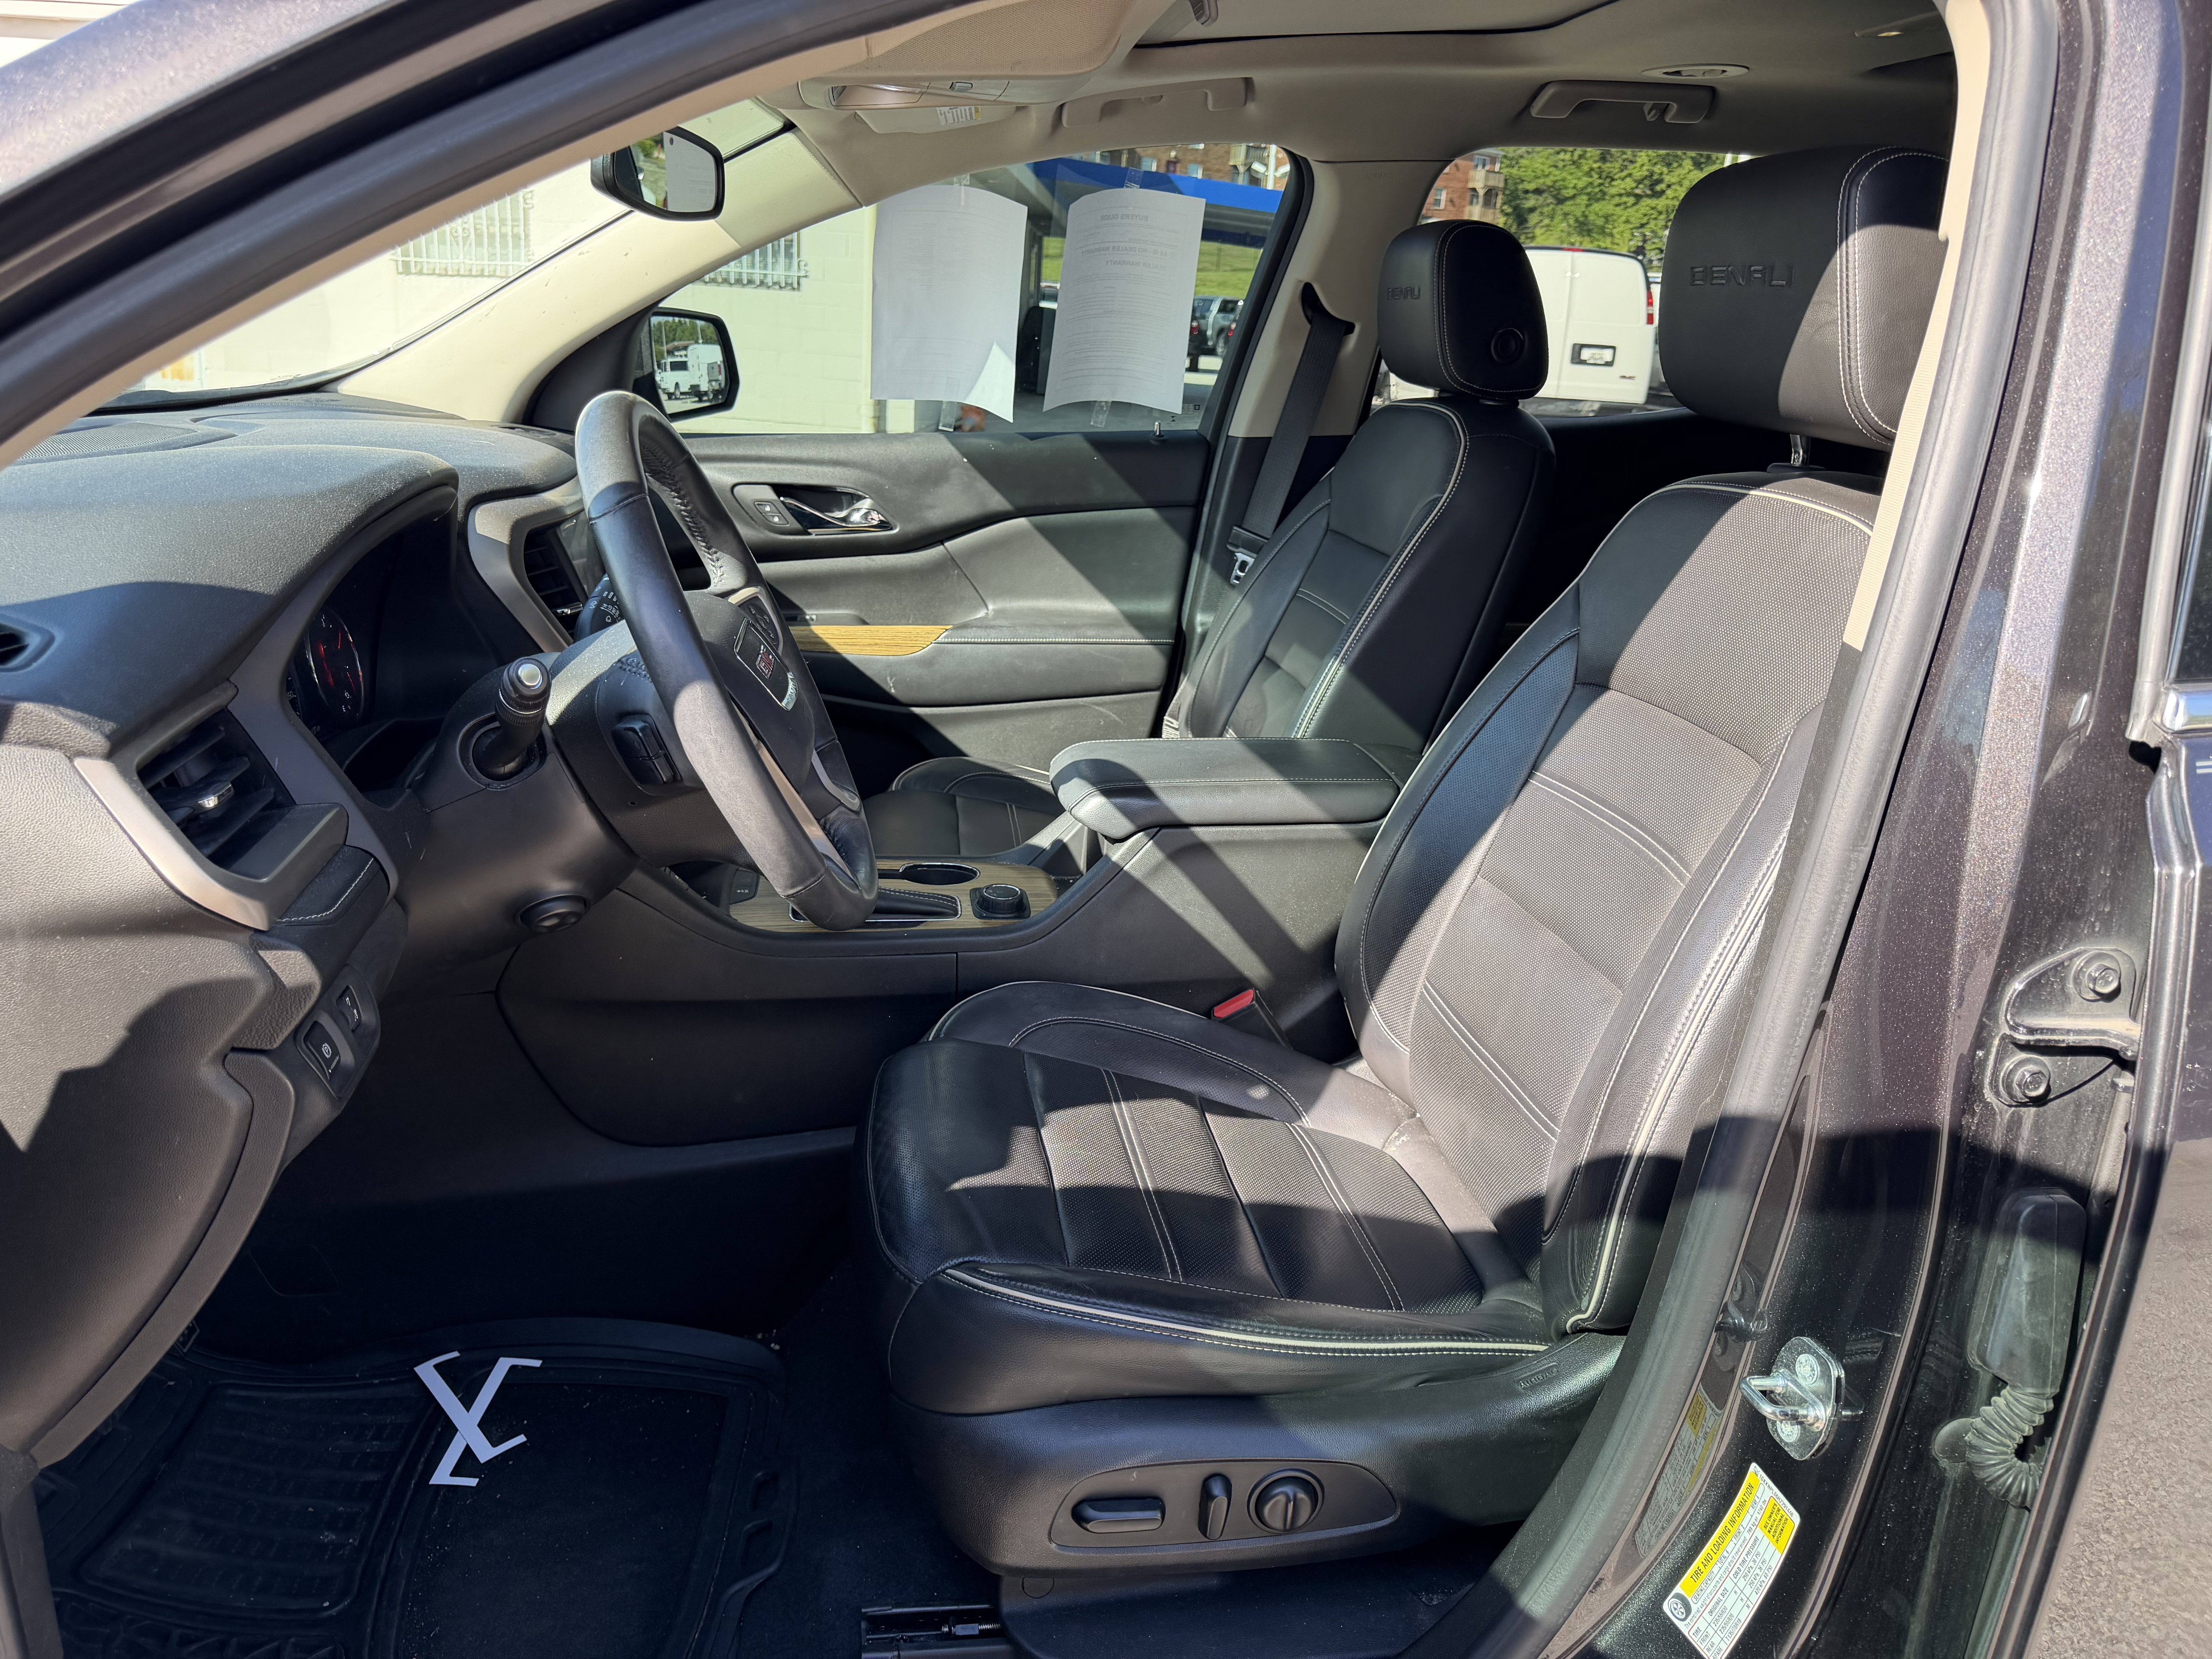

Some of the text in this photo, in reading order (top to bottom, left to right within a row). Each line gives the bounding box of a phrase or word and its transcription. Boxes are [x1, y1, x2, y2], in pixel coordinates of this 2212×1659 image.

[1690, 265, 1795, 287] DENALI
[1690, 1482, 1754, 1583] TIRE AND LOADING INFORMATION
[1767, 1516, 1777, 1534] MANUAL
[1693, 1535, 1759, 1638] TIRE ORIGINAL SIZE COLD TIRE PRESSURE
[1694, 1586, 1705, 1601] SEATING
[1703, 1570, 1715, 1587] CAPACITY
[1718, 1553, 1727, 1565] TOTAL
[1699, 1630, 1711, 1646] FRONT
[1706, 1641, 1716, 1653] REAR
